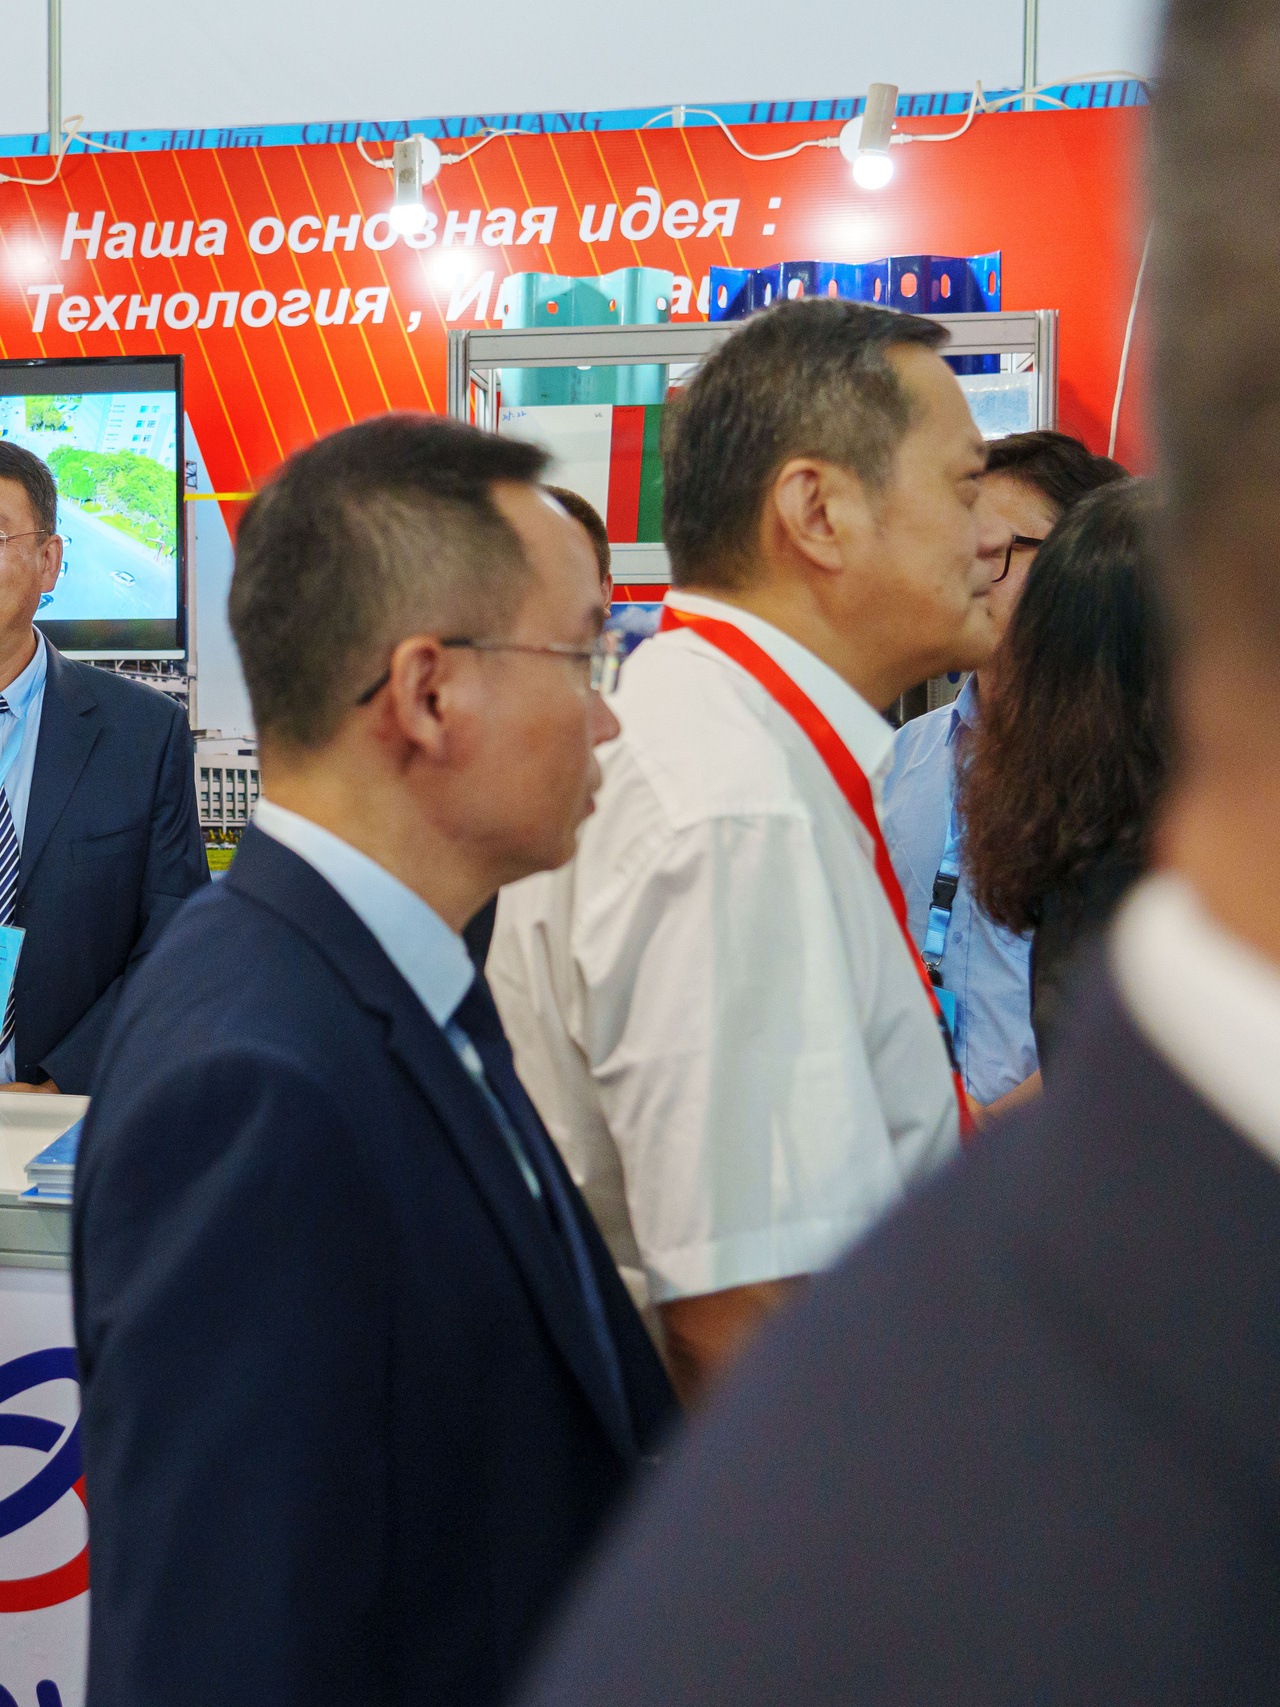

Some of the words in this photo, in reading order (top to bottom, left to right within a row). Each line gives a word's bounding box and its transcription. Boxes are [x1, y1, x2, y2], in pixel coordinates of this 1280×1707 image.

[60, 211, 228, 260] Наша
[248, 206, 558, 255] основная
[579, 186, 741, 243] идея
[26, 284, 390, 333] Технология
